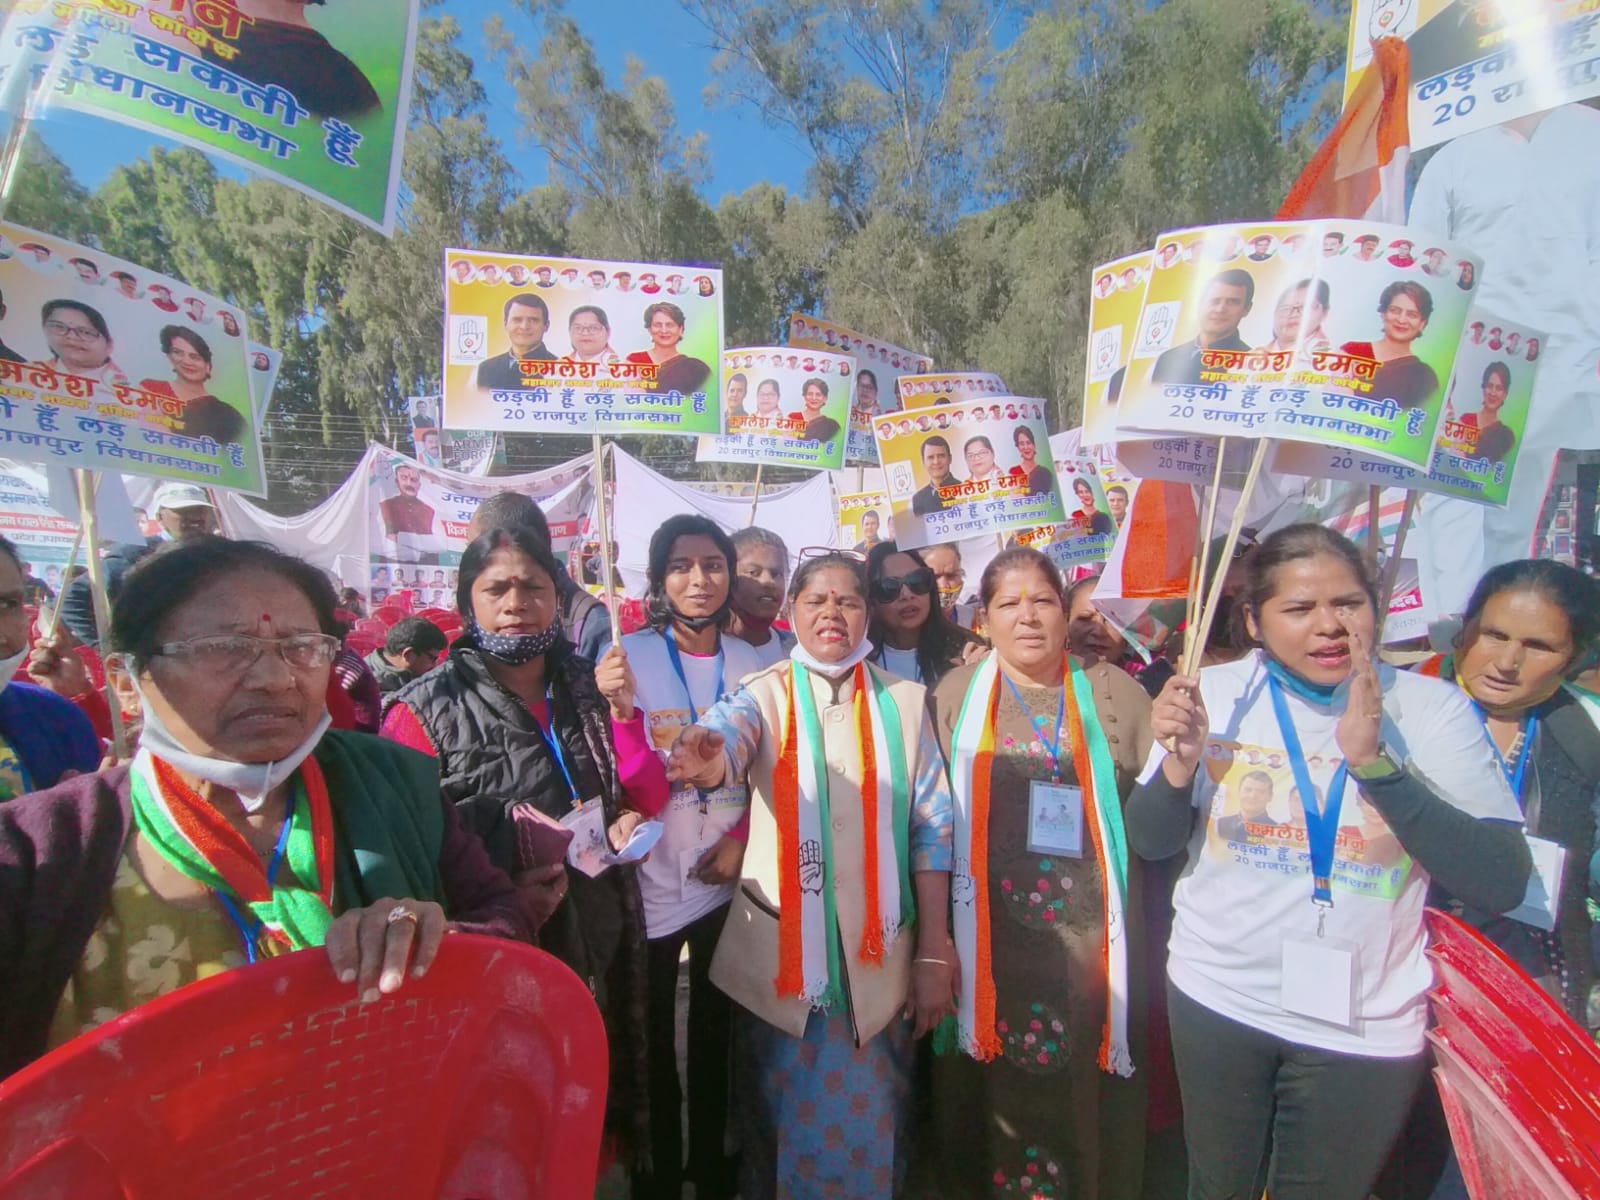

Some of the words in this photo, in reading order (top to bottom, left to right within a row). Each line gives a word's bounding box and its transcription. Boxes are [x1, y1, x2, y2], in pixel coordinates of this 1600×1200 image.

[131, 33, 309, 127] सकती
[322, 117, 363, 167] हूँ
[1432, 94, 1476, 127] 20
[518, 356, 600, 378] कमलेश
[608, 363, 660, 379] रमन
[1201, 349, 1294, 372] कमलेश
[1312, 352, 1383, 380] रमन
[0, 358, 100, 398] मलेश
[112, 383, 187, 417] रमन
[492, 388, 551, 404] लड़की
[560, 388, 576, 408] हूँ
[584, 392, 615, 408] लड़
[624, 389, 682, 406] सकती
[692, 392, 707, 413] हूँ
[1163, 383, 1231, 402] लड़की
[1241, 385, 1262, 409] हूँ
[1269, 388, 1309, 408] लड़
[1321, 391, 1401, 421] सकती
[1407, 408, 1427, 435] हूँ
[503, 408, 526, 420] 20
[532, 411, 587, 425] राजपुर
[595, 409, 682, 424] विधानसभा
[1169, 404, 1194, 418] 20
[1203, 408, 1267, 428] राजपुर
[1275, 409, 1391, 442] विधानसभा
[32, 402, 60, 432] हूँ
[75, 415, 127, 441] लड़
[140, 427, 219, 456] सकती
[1444, 420, 1482, 443] रमन
[0, 428, 84, 456] ाजपुर
[95, 440, 220, 476] विधानसभा
[453, 439, 494, 449] ARME
[1158, 456, 1173, 468] 20
[1330, 456, 1353, 469] 20
[1359, 460, 1417, 480] राजपुर
[1448, 455, 1492, 475] सकती
[938, 479, 991, 498] कमलेश
[997, 474, 1029, 489] रमन
[935, 525, 950, 535] 20
[1234, 853, 1250, 865] 20
